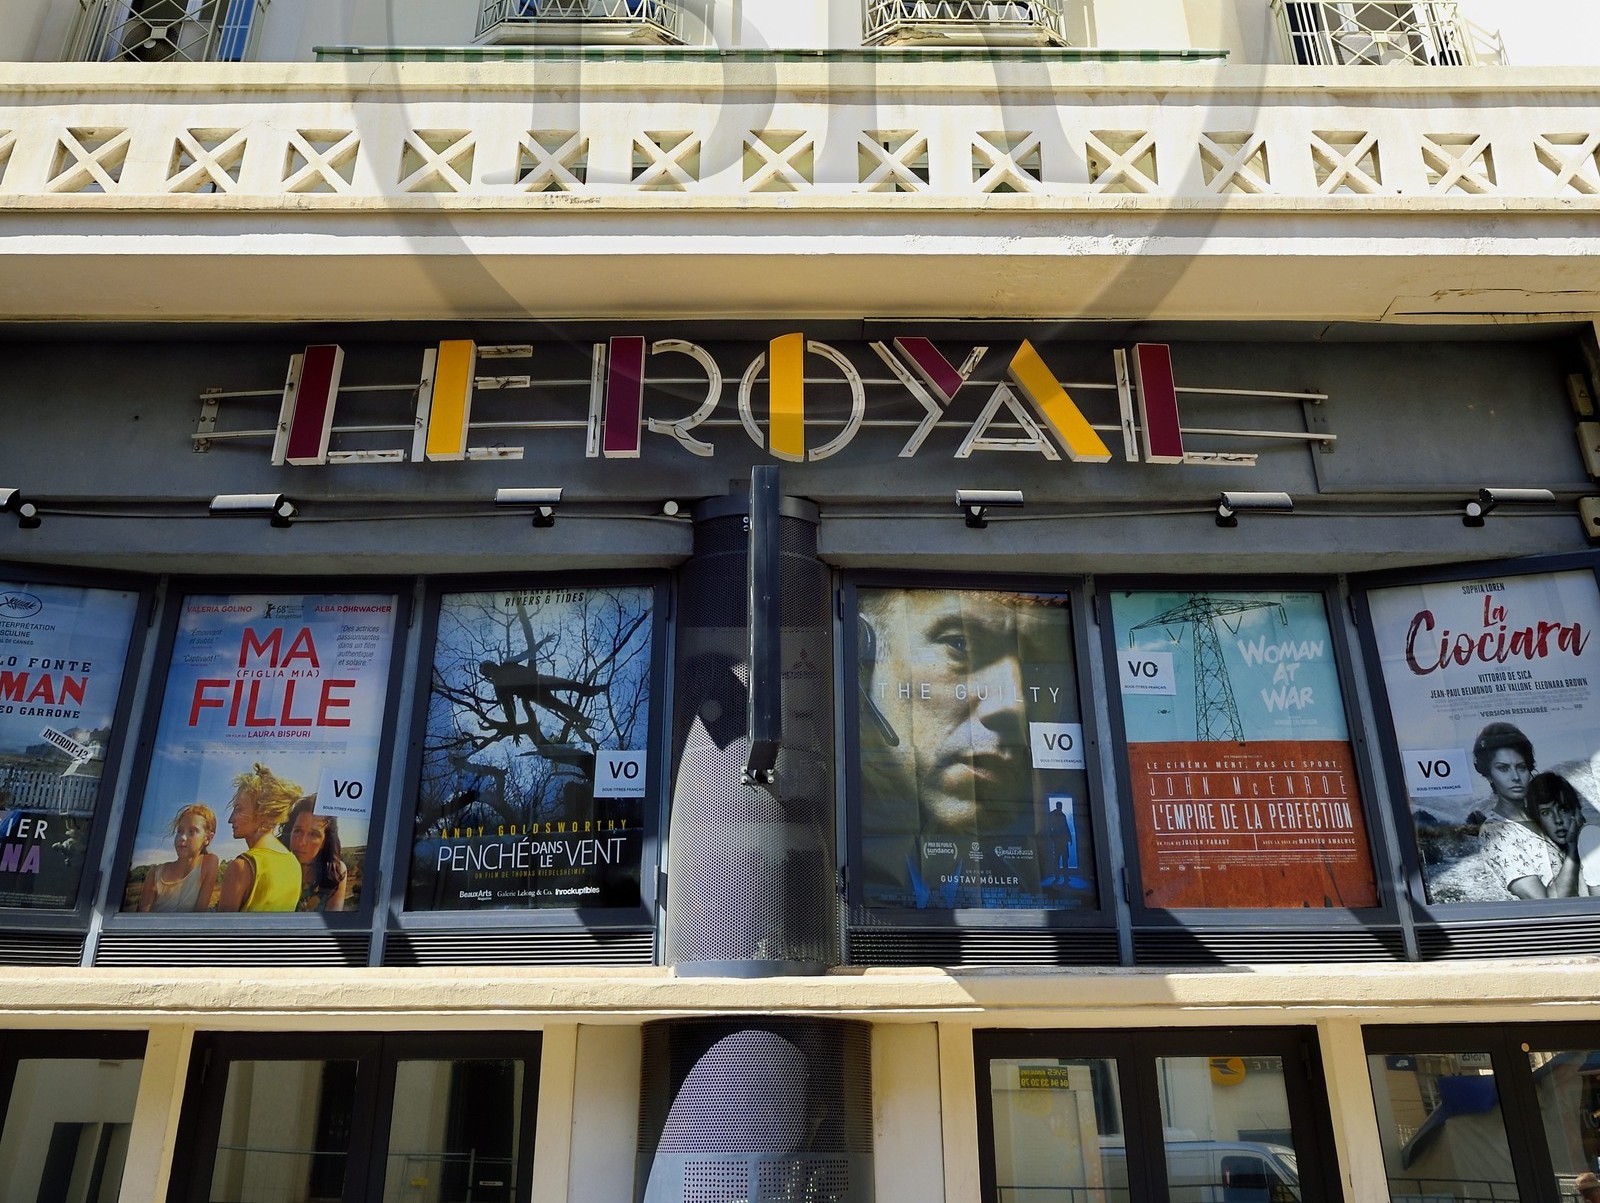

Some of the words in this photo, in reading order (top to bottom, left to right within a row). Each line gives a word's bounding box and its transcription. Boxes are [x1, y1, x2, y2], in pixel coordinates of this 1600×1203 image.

[271, 338, 533, 466] LE
[585, 332, 1258, 466] ROYAL
[1462, 585, 1485, 595] SOPHIA
[1485, 582, 1505, 592] LOREN
[505, 596, 541, 607] RIVERS
[556, 592, 584, 604] TIDES
[337, 605, 392, 613] ROHRWACHER
[1483, 595, 1508, 627] La
[0, 629, 30, 637] SCULINE
[238, 627, 320, 668] MA
[1406, 610, 1591, 675] Ciociara
[28, 658, 92, 673] FONTE
[237, 670, 284, 678] (FIGLIA
[291, 670, 320, 678] MIA)
[1128, 660, 1158, 678] VO
[1478, 673, 1506, 683] VITTORIO
[1507, 672, 1516, 680] DE
[1517, 670, 1532, 680] SICA
[878, 682, 931, 700] THE
[955, 684, 1060, 703] GUILTY
[1430, 688, 1460, 698] JEAN-PAUL
[1461, 685, 1493, 695] BELMONDO
[1496, 684, 1506, 693] RAF
[1507, 682, 1532, 691] VALLONE
[1565, 678, 1588, 687] BROWN
[188, 680, 356, 727] FILLE
[1260, 686, 1314, 713] WAR
[19, 707, 80, 719] GARRONE
[1480, 709, 1511, 717] VERSION
[1512, 706, 1548, 715] RESTAURÉE
[248, 730, 275, 738] LAURA
[277, 730, 311, 738] BISPURI
[1043, 733, 1073, 751] VO
[609, 761, 639, 779] VO
[1167, 760, 1207, 769] CINÉMA
[1303, 760, 1342, 768] SPORT.
[1418, 760, 1451, 778] VO
[334, 780, 363, 800] VO
[1150, 777, 1209, 796] JOHN
[1221, 803, 1239, 830] DE
[1244, 803, 1262, 829] LA
[1269, 802, 1353, 829] PERFECTION
[442, 827, 484, 839] ANDY
[498, 819, 627, 836] GOLDSWORTHY
[437, 837, 530, 871] PENCHÉ
[531, 841, 563, 855] DANS
[564, 837, 627, 866] VENT
[540, 855, 553, 868] LE
[940, 875, 976, 884] GUSTAV
[980, 875, 1019, 885] MÖLLER
